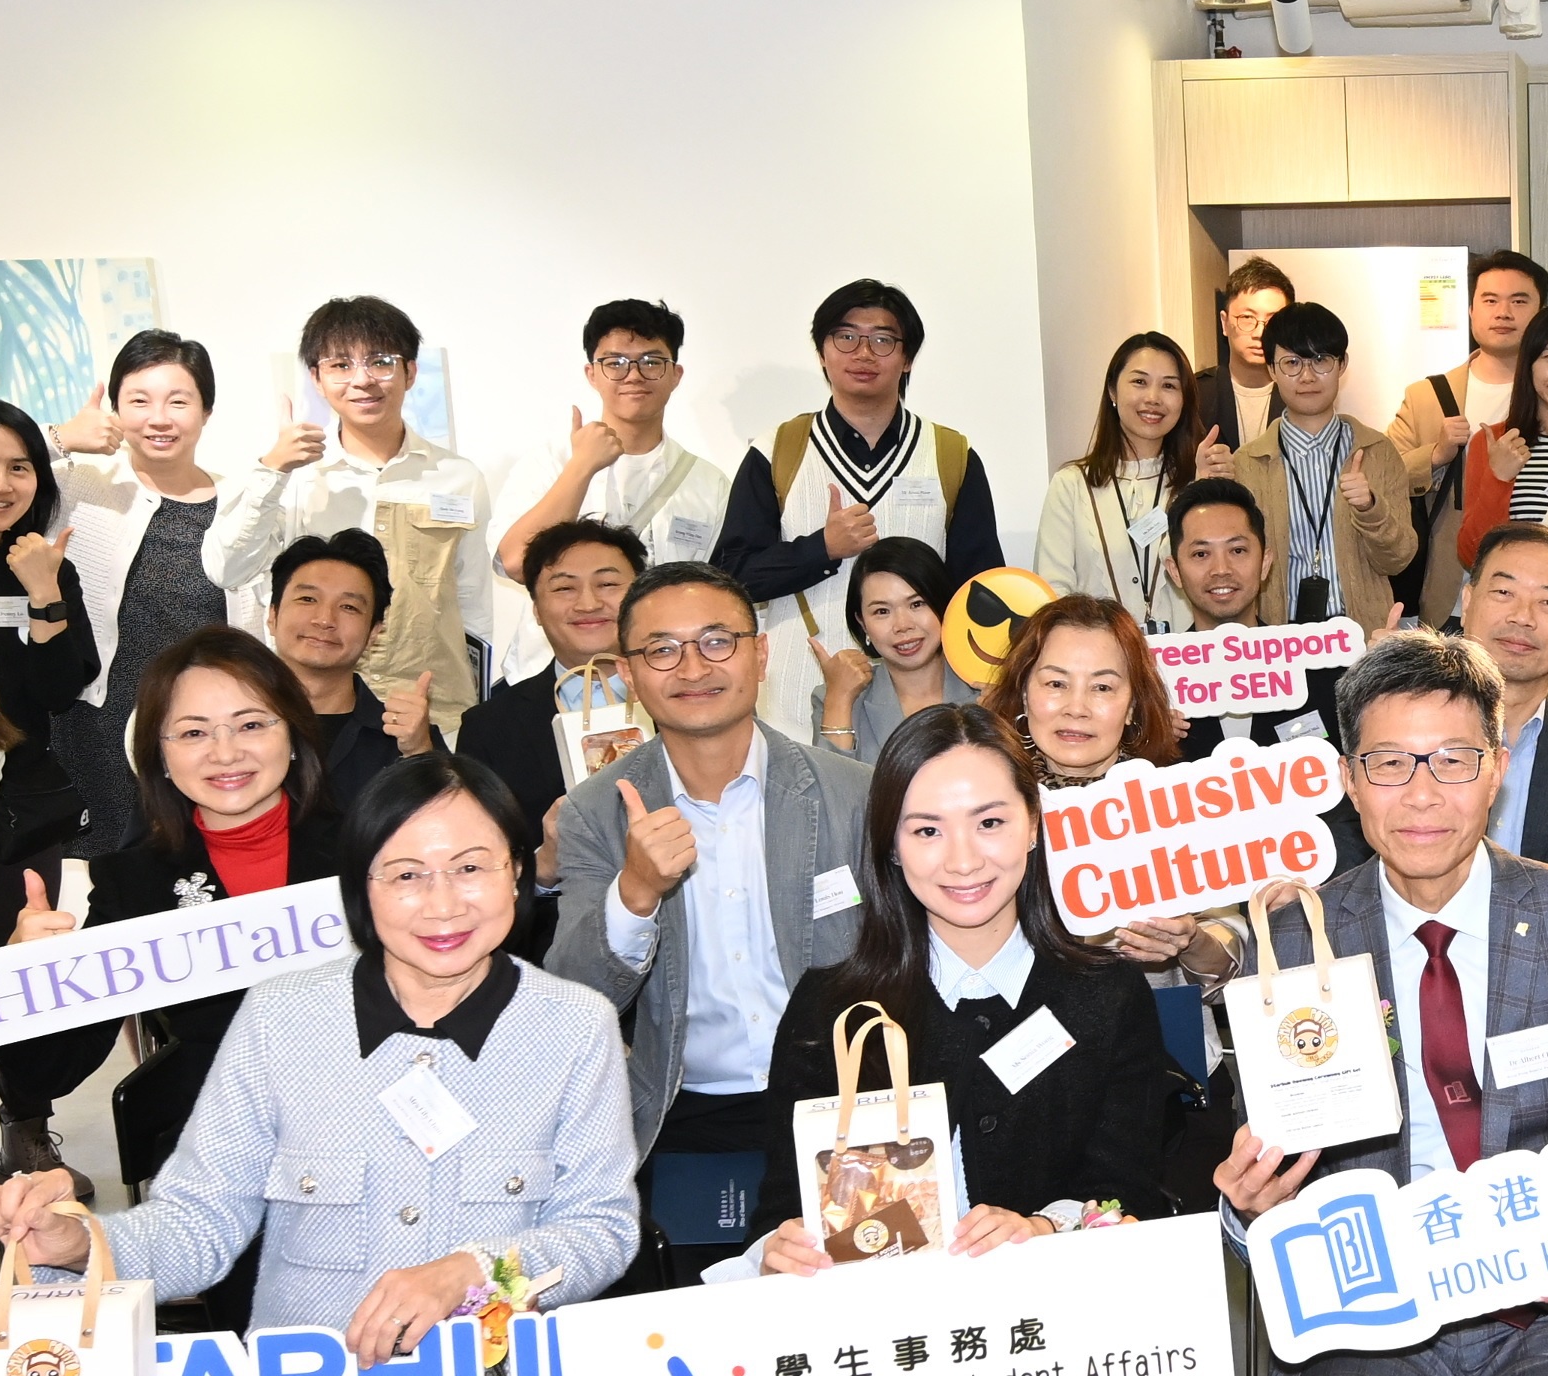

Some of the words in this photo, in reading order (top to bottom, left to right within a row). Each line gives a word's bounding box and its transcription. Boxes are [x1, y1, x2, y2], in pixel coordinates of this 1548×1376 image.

[1149, 635, 1215, 667] reer
[1223, 627, 1352, 675] Support
[1175, 673, 1224, 703] for
[1230, 670, 1294, 701] SEN
[1042, 754, 1329, 852] nclusive
[1060, 827, 1319, 920] Culture
[1427, 1246, 1529, 1302] HONG
